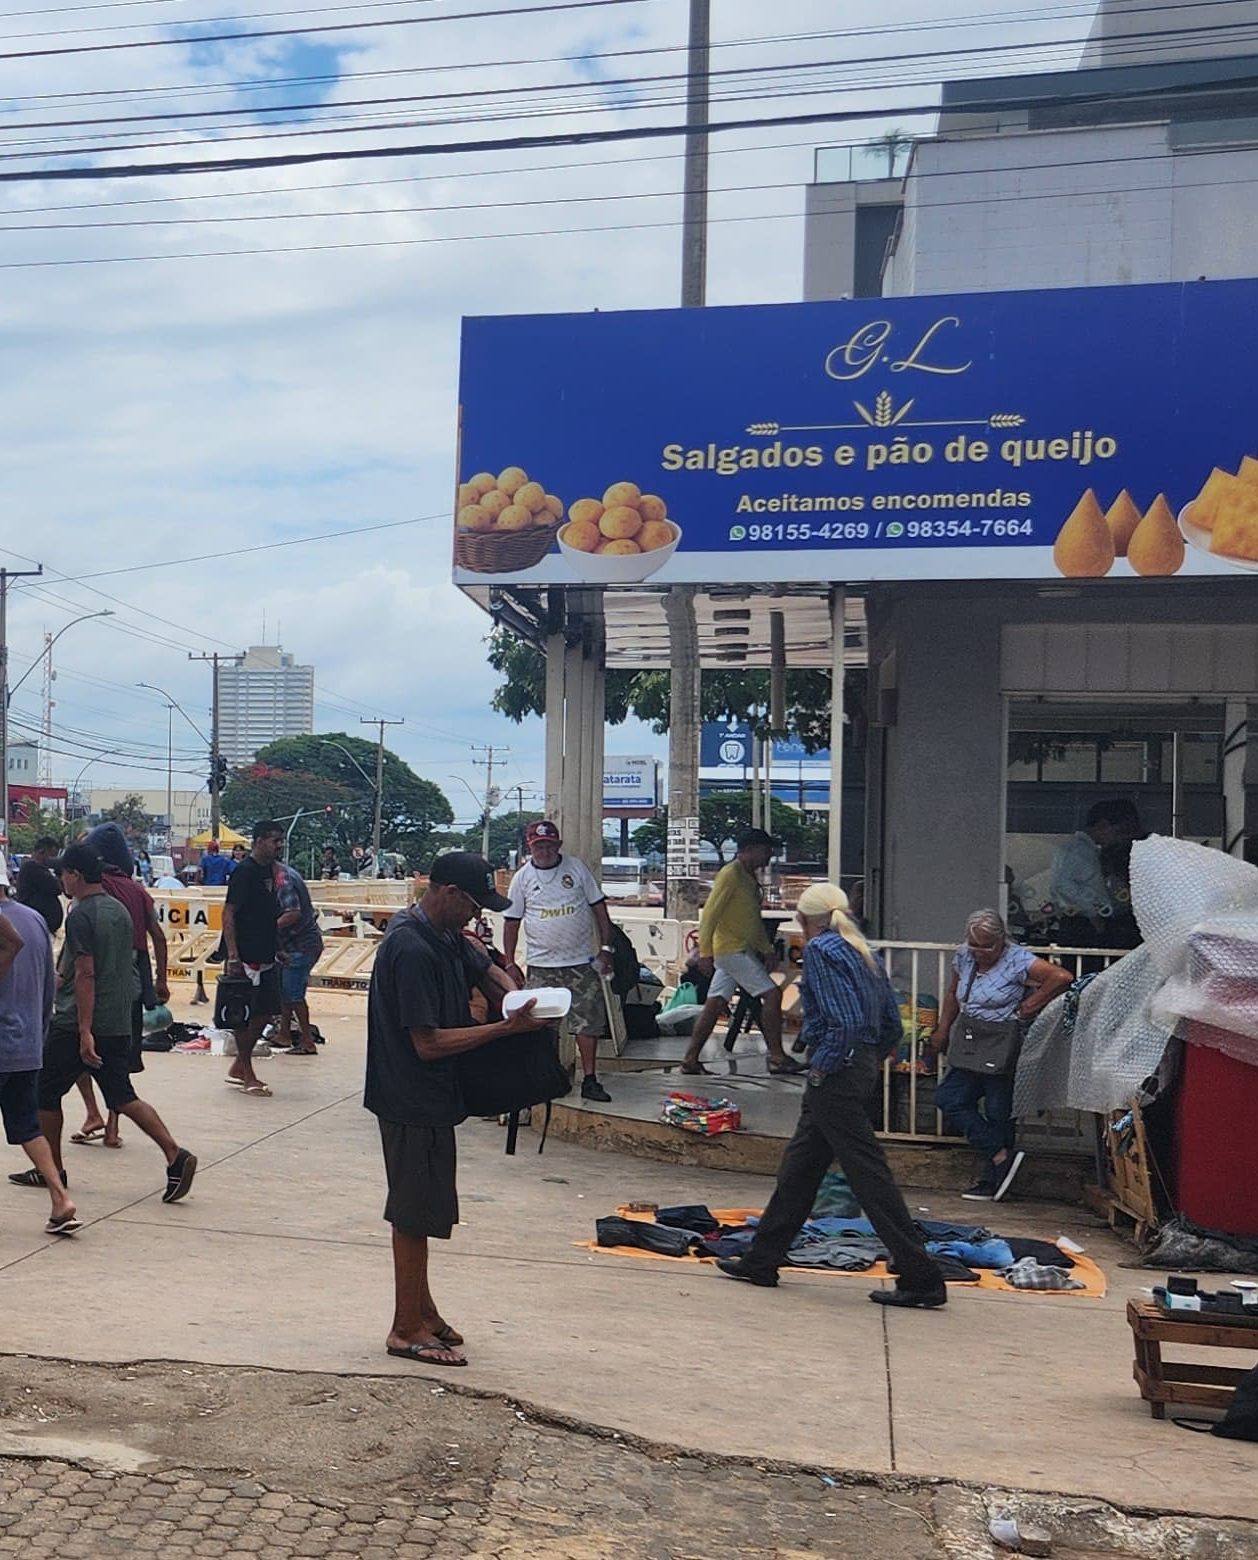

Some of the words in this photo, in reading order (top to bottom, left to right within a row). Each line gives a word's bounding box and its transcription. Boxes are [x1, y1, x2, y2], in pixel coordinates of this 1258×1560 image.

[825, 316, 973, 381] G.L
[661, 441, 823, 476] Salgados
[834, 444, 856, 466] e
[866, 436, 933, 471] pão
[944, 435, 989, 463] de
[1000, 430, 1117, 467] queijo
[736, 493, 864, 514] Aceitamos
[871, 489, 1032, 510] encomendas
[748, 521, 869, 541] 98155-4269
[906, 518, 1033, 538] 98354-7664
[602, 775, 641, 784] atarata
[159, 904, 209, 925] ÍCIA
